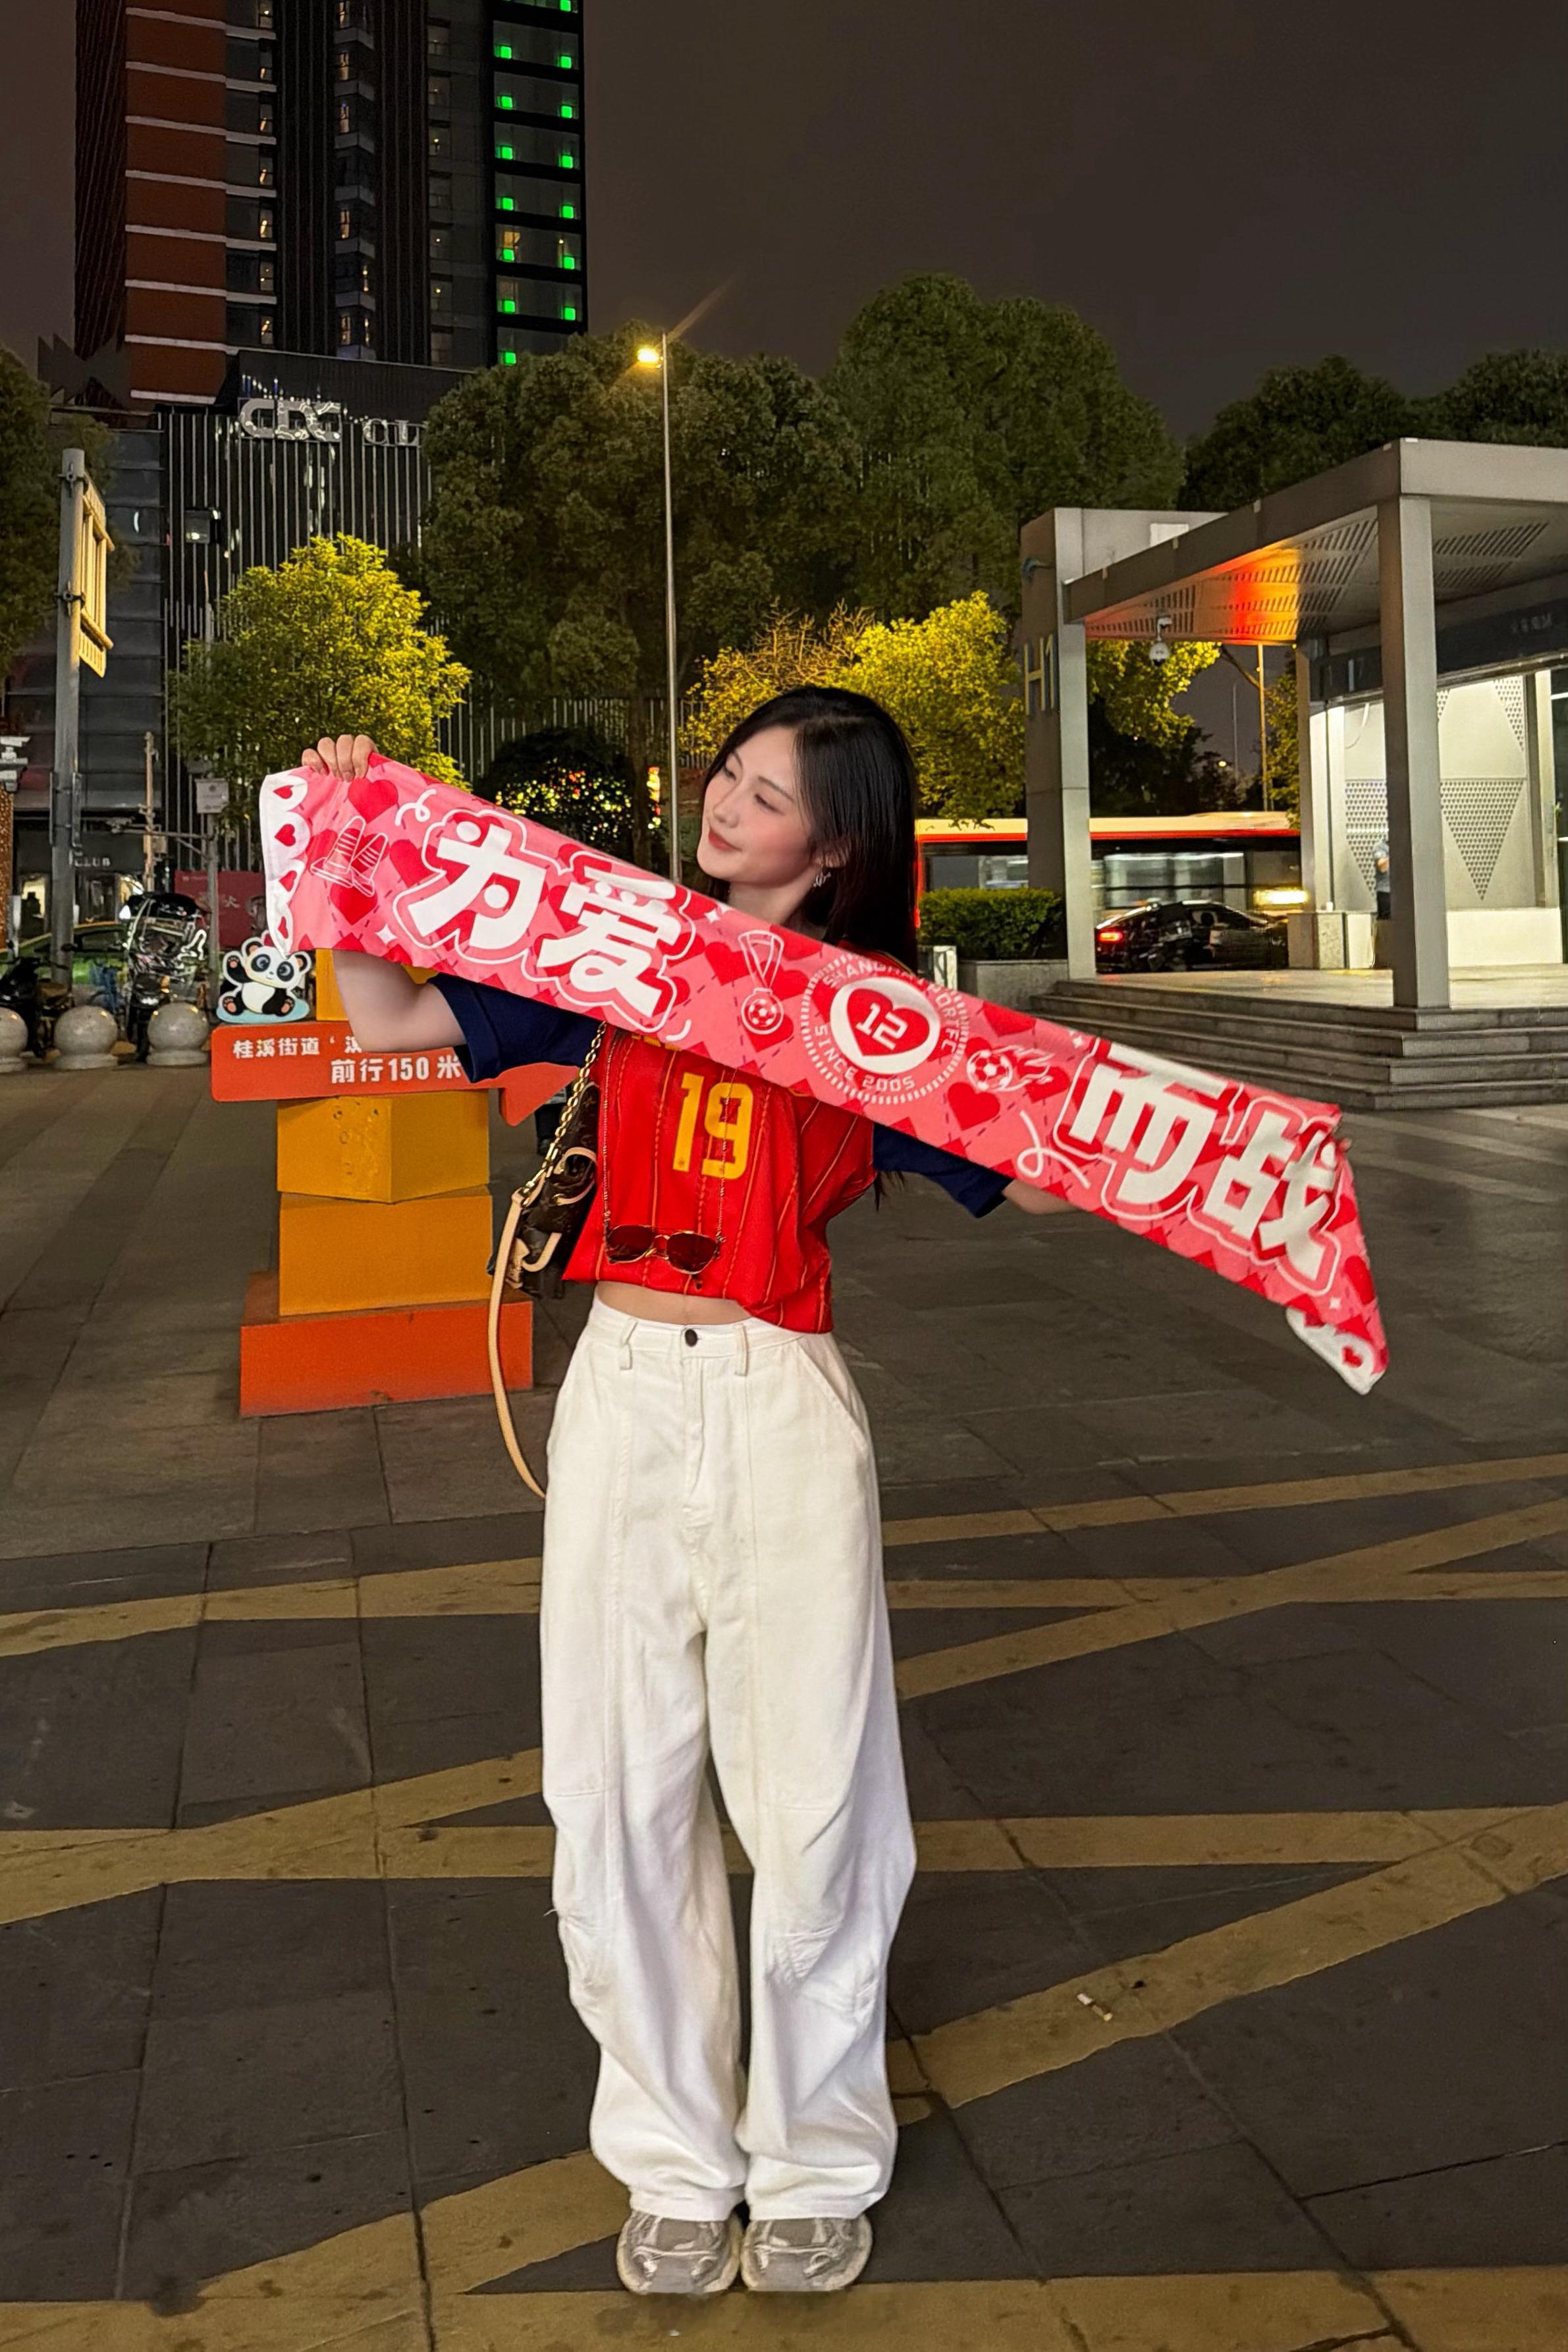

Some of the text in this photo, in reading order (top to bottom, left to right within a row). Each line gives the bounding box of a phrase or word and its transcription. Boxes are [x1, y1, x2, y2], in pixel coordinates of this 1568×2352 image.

[1023, 633, 1058, 716] H1
[814, 1024, 915, 1092] SINCE 2005
[855, 1002, 909, 1051] 12
[672, 1072, 754, 1180] 19
